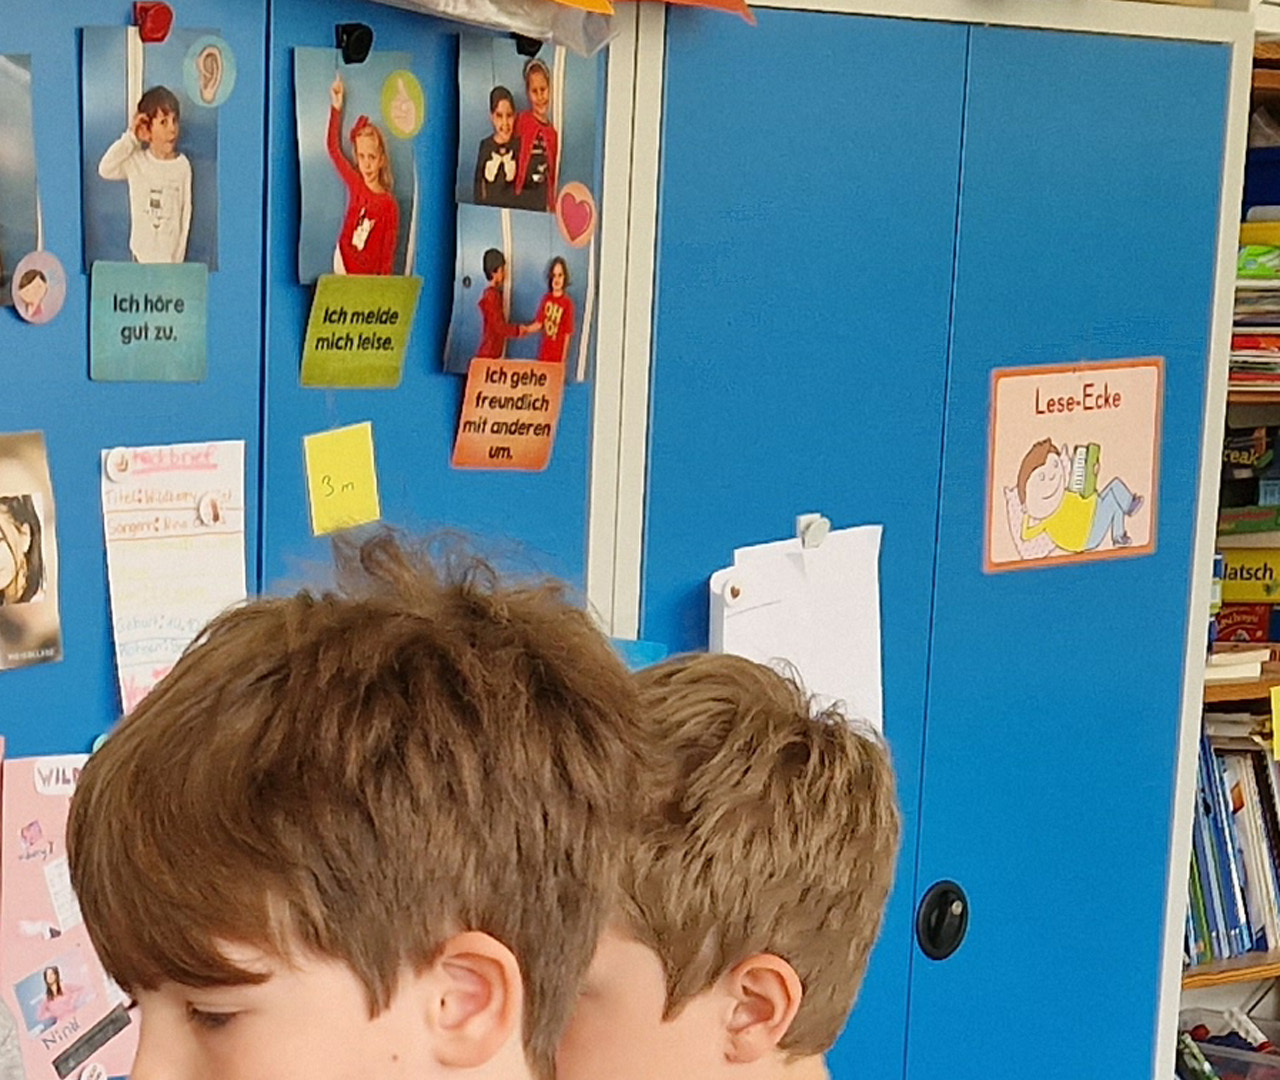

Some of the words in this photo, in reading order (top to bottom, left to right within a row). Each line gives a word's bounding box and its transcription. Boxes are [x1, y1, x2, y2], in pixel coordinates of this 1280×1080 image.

[113, 293, 140, 313] Ich
[144, 293, 185, 313] höre
[322, 306, 348, 325] Ich
[350, 307, 399, 325] melde
[120, 322, 149, 344] gut
[154, 326, 178, 341] zu.
[315, 333, 353, 350] mich
[357, 333, 395, 350] leise.
[484, 366, 507, 385] Ich
[510, 367, 548, 389] gehe
[475, 391, 549, 412] freundlich
[1035, 382, 1122, 415] Lese-Ecke
[462, 416, 487, 434] mit
[491, 418, 551, 437] anderen
[488, 445, 513, 460] um.
[1223, 448, 1257, 465] reak
[321, 475, 335, 497] 3
[1219, 562, 1274, 581] latsch
